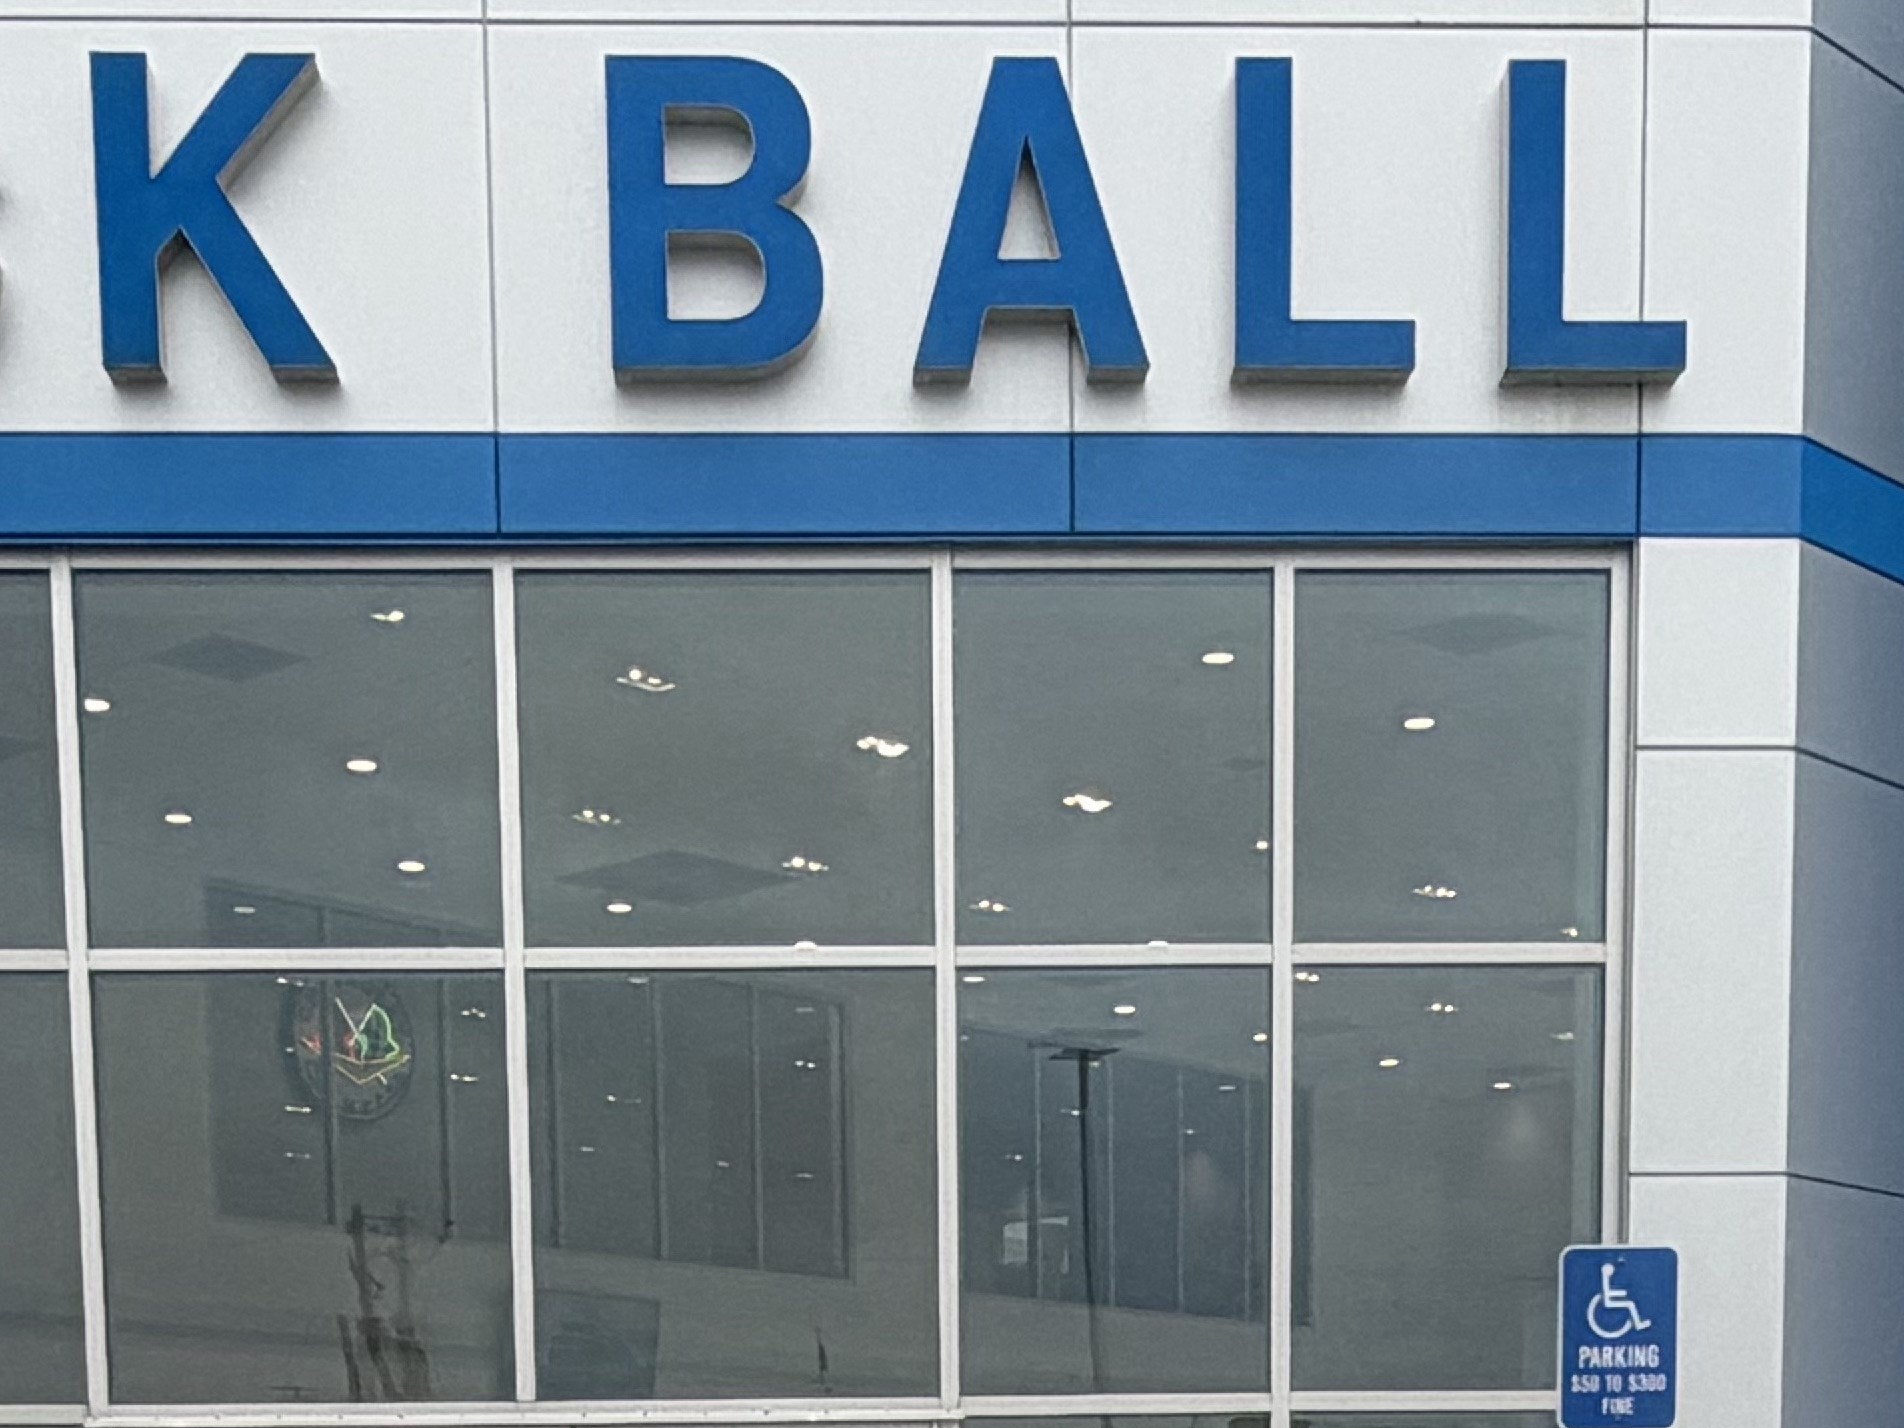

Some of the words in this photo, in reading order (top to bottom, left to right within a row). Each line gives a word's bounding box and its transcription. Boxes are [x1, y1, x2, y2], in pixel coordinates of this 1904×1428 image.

[605, 54, 1688, 386] BALL
[1578, 1344, 1659, 1369] PARKING
[1571, 1374, 1600, 1393] $50
[1605, 1374, 1622, 1393] TO
[1628, 1373, 1666, 1392] $300
[1601, 1396, 1635, 1416] FINE
